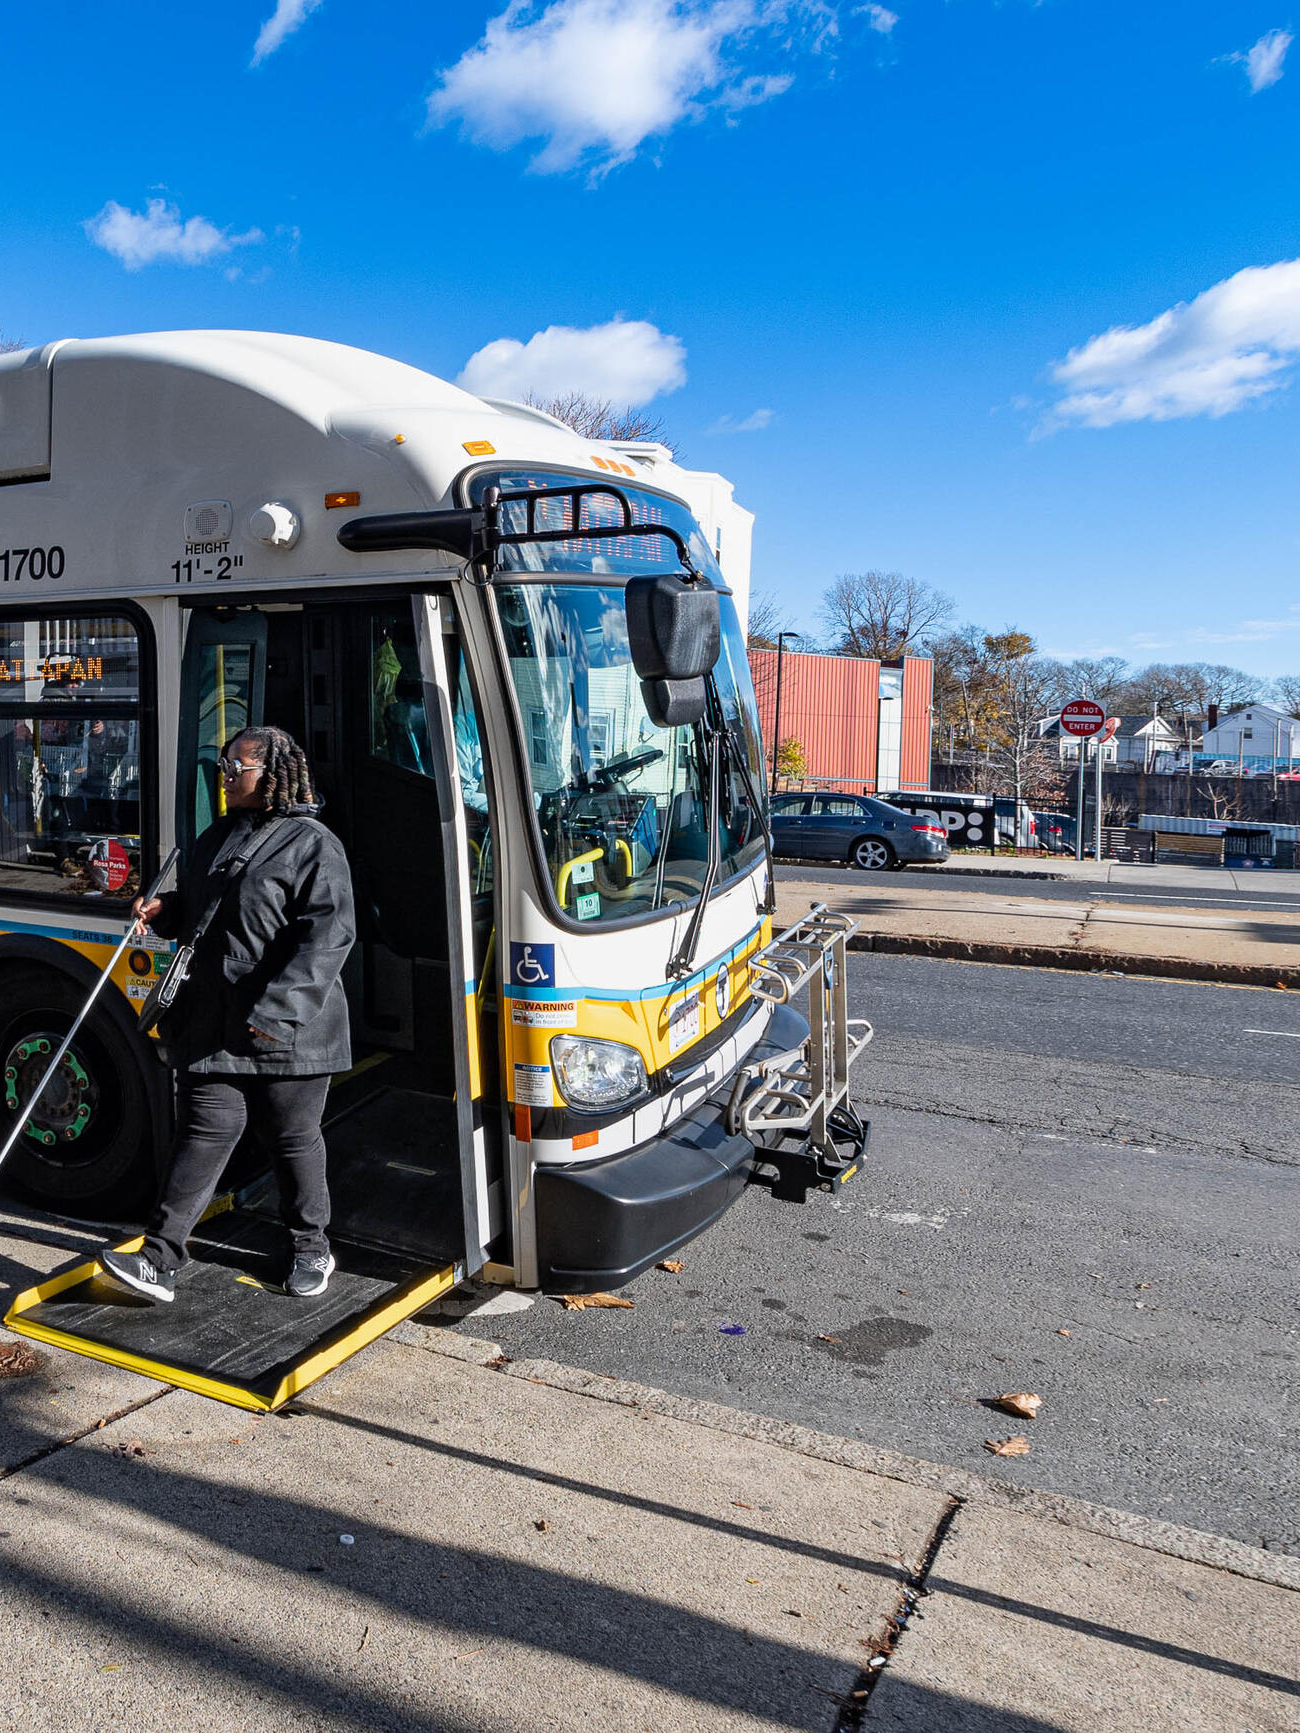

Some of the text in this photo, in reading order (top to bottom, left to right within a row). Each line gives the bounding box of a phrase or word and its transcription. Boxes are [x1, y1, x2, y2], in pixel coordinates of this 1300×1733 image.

[185, 541, 230, 556] HEIGHT
[1082, 706, 1099, 714] NOT
[93, 859, 127, 870] Rosa Parks
[72, 930, 100, 943] SEATS
[135, 978, 156, 988] CAUT
[524, 1001, 574, 1012] WARNING
